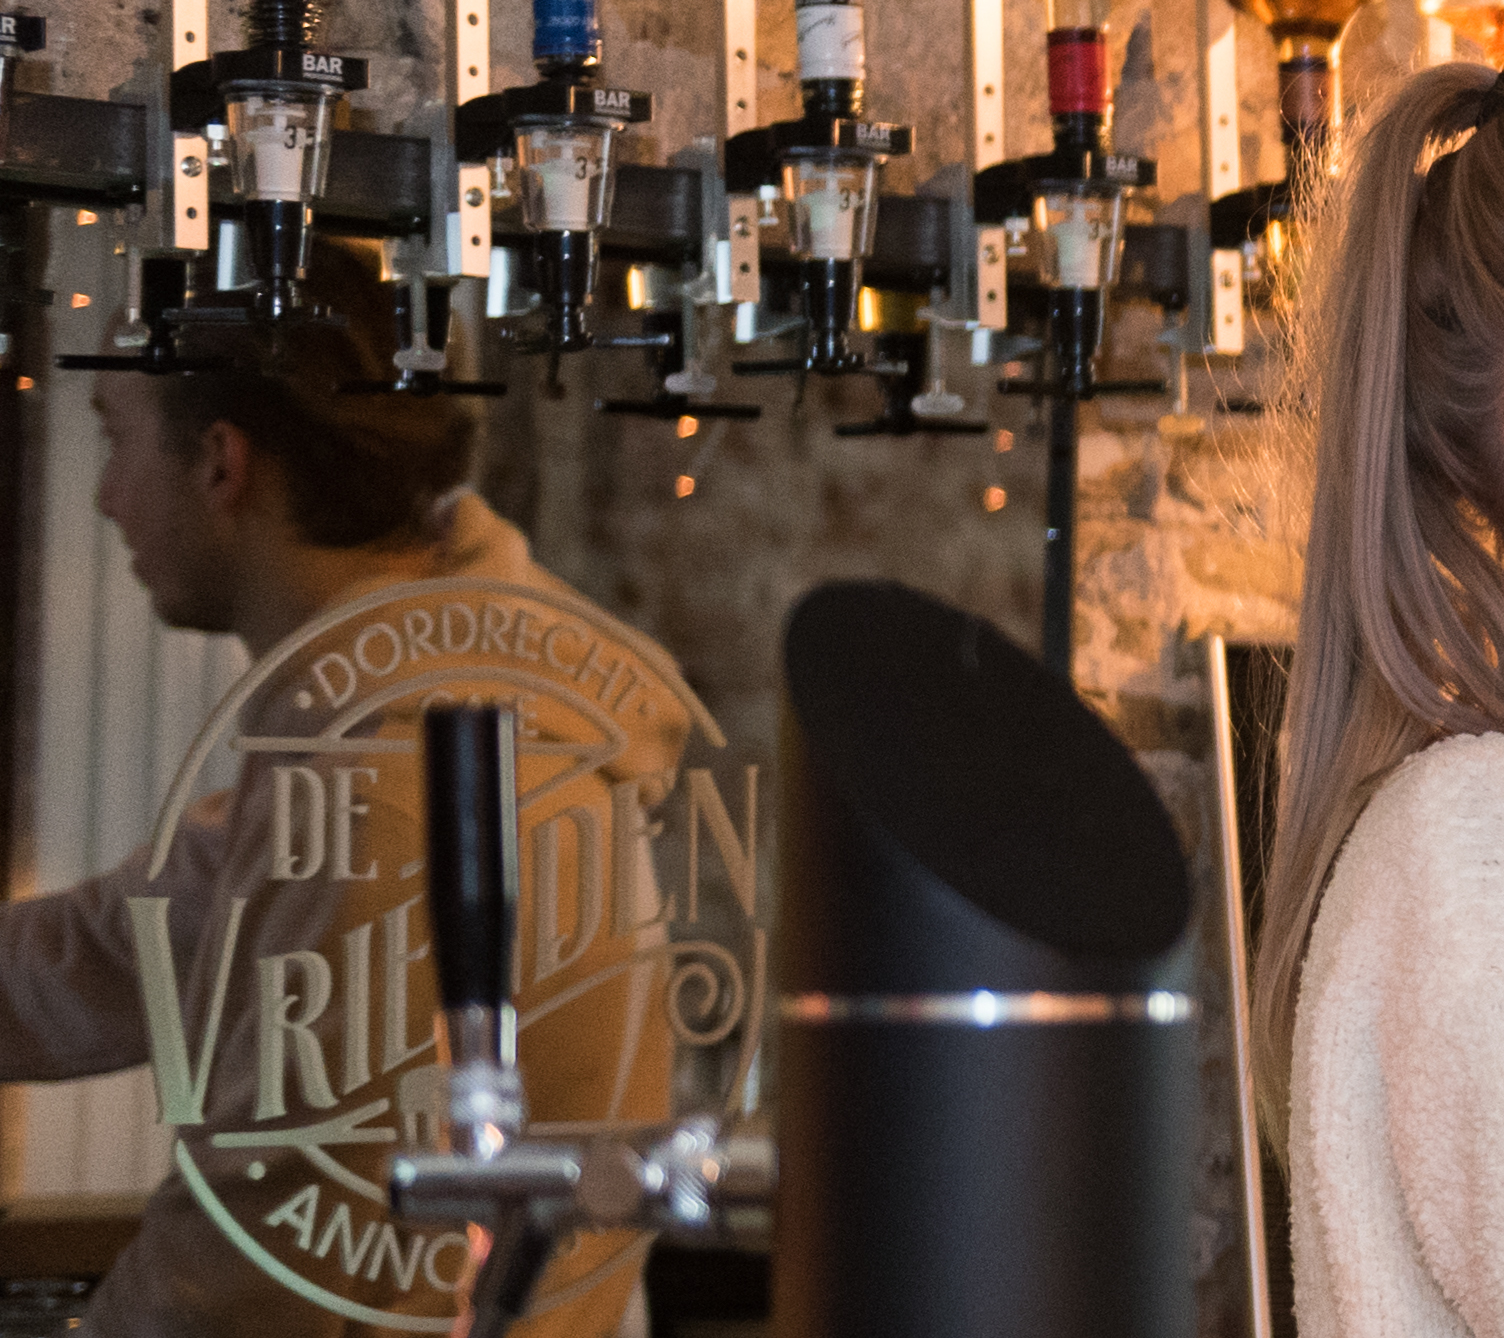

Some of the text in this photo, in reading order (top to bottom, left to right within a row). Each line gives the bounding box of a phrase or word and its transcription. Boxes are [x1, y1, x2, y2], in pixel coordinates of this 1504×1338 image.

[302, 53, 343, 74] BAR
[594, 89, 631, 108] BAR
[856, 122, 891, 140] BAR
[311, 601, 655, 714] DORDRECHT
[270, 765, 378, 881] DE
[126, 764, 760, 1126] VRIEDEN
[264, 1183, 474, 1293] ANNO
